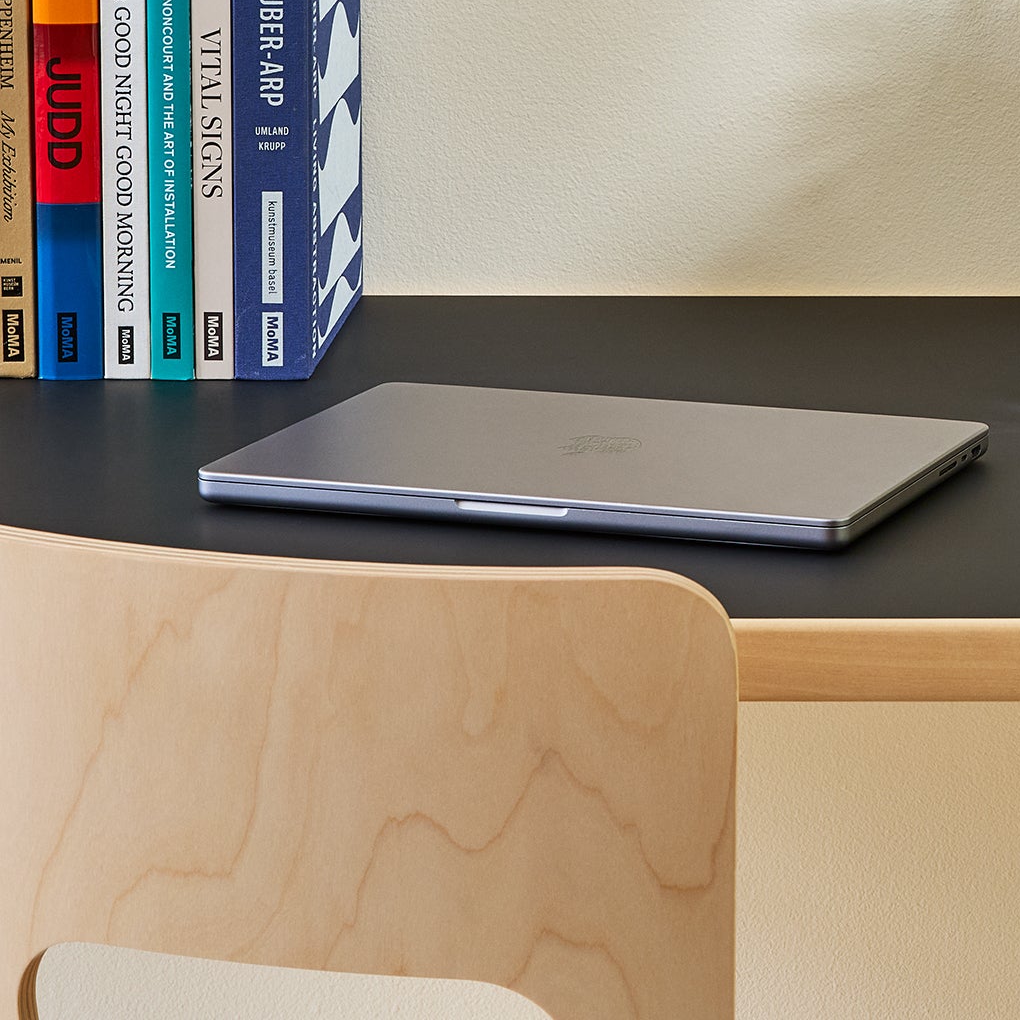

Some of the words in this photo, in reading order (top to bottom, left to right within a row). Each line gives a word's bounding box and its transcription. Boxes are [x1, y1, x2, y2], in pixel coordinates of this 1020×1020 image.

[114, 6, 132, 68] GOOD
[163, 74, 174, 101] AND
[201, 27, 222, 110] VITAL
[0, 110, 16, 139] My
[46, 57, 83, 170] JUDD
[115, 73, 133, 141] NIGHT
[163, 103, 175, 129] THE
[163, 131, 175, 157] ART
[255, 126, 289, 136] UMLAND
[258, 142, 286, 151] KRUPP
[116, 146, 133, 207] GOOD
[163, 159, 175, 177] OF
[201, 116, 223, 199] SIGNS
[2, 140, 17, 223] Exhibition
[164, 179, 176, 269] INSTALLATION
[268, 200, 278, 266] kunstmuseum
[117, 211, 134, 312] MORNING
[268, 270, 278, 295] basel
[6, 313, 20, 358] MoMA
[61, 316, 74, 359] MoMA
[121, 329, 131, 362] MoMA
[166, 316, 177, 356] MoMA
[207, 316, 220, 357] MoMA
[267, 316, 279, 362] MoMA
